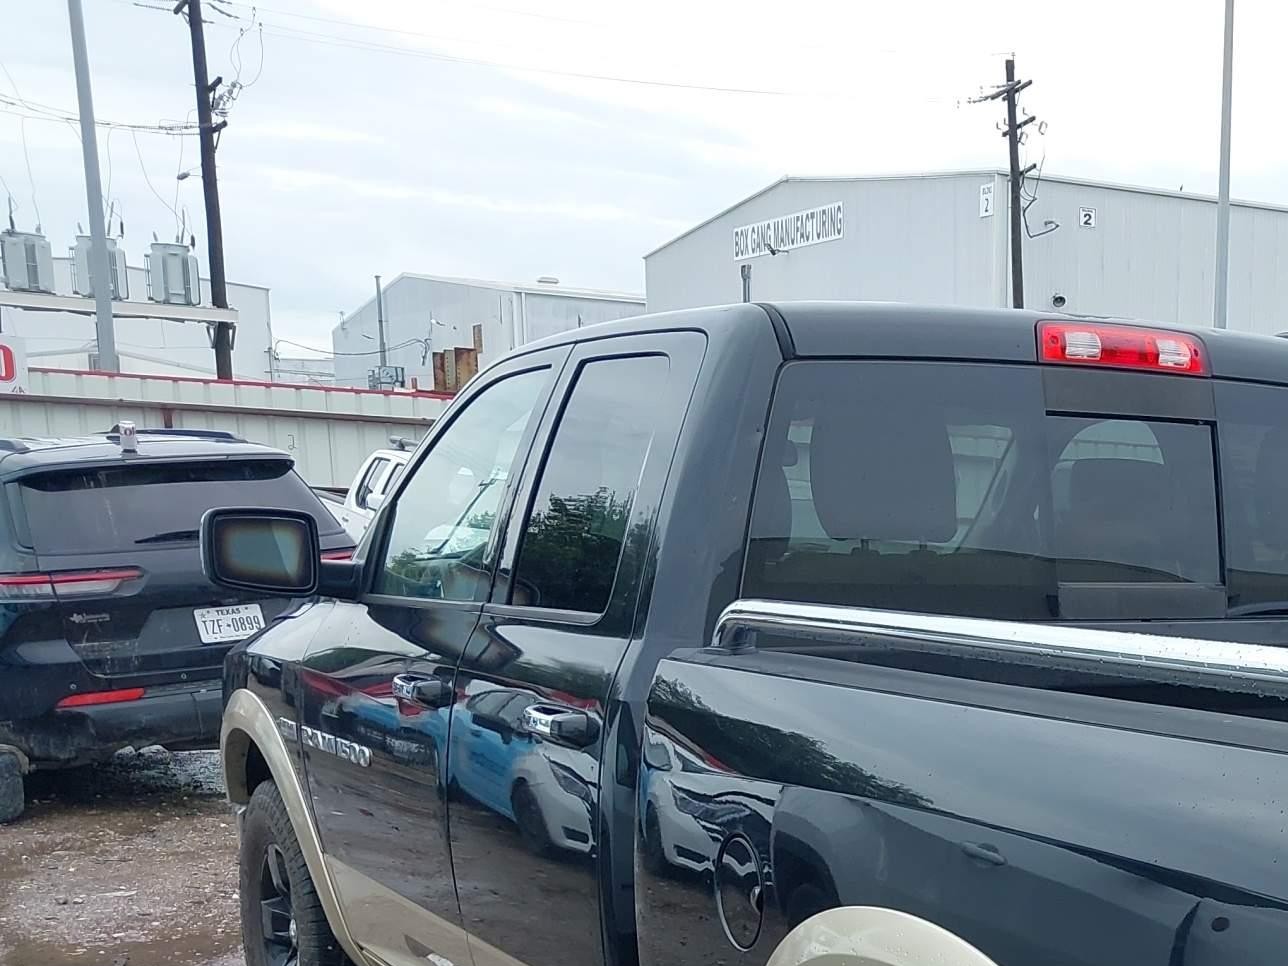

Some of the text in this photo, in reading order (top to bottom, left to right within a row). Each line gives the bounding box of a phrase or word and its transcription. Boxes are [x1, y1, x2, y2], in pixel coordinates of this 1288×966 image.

[1083, 213, 1092, 225] 2
[735, 205, 842, 257] BOX GANG MANUFACTURING
[215, 607, 241, 616] TEXAS
